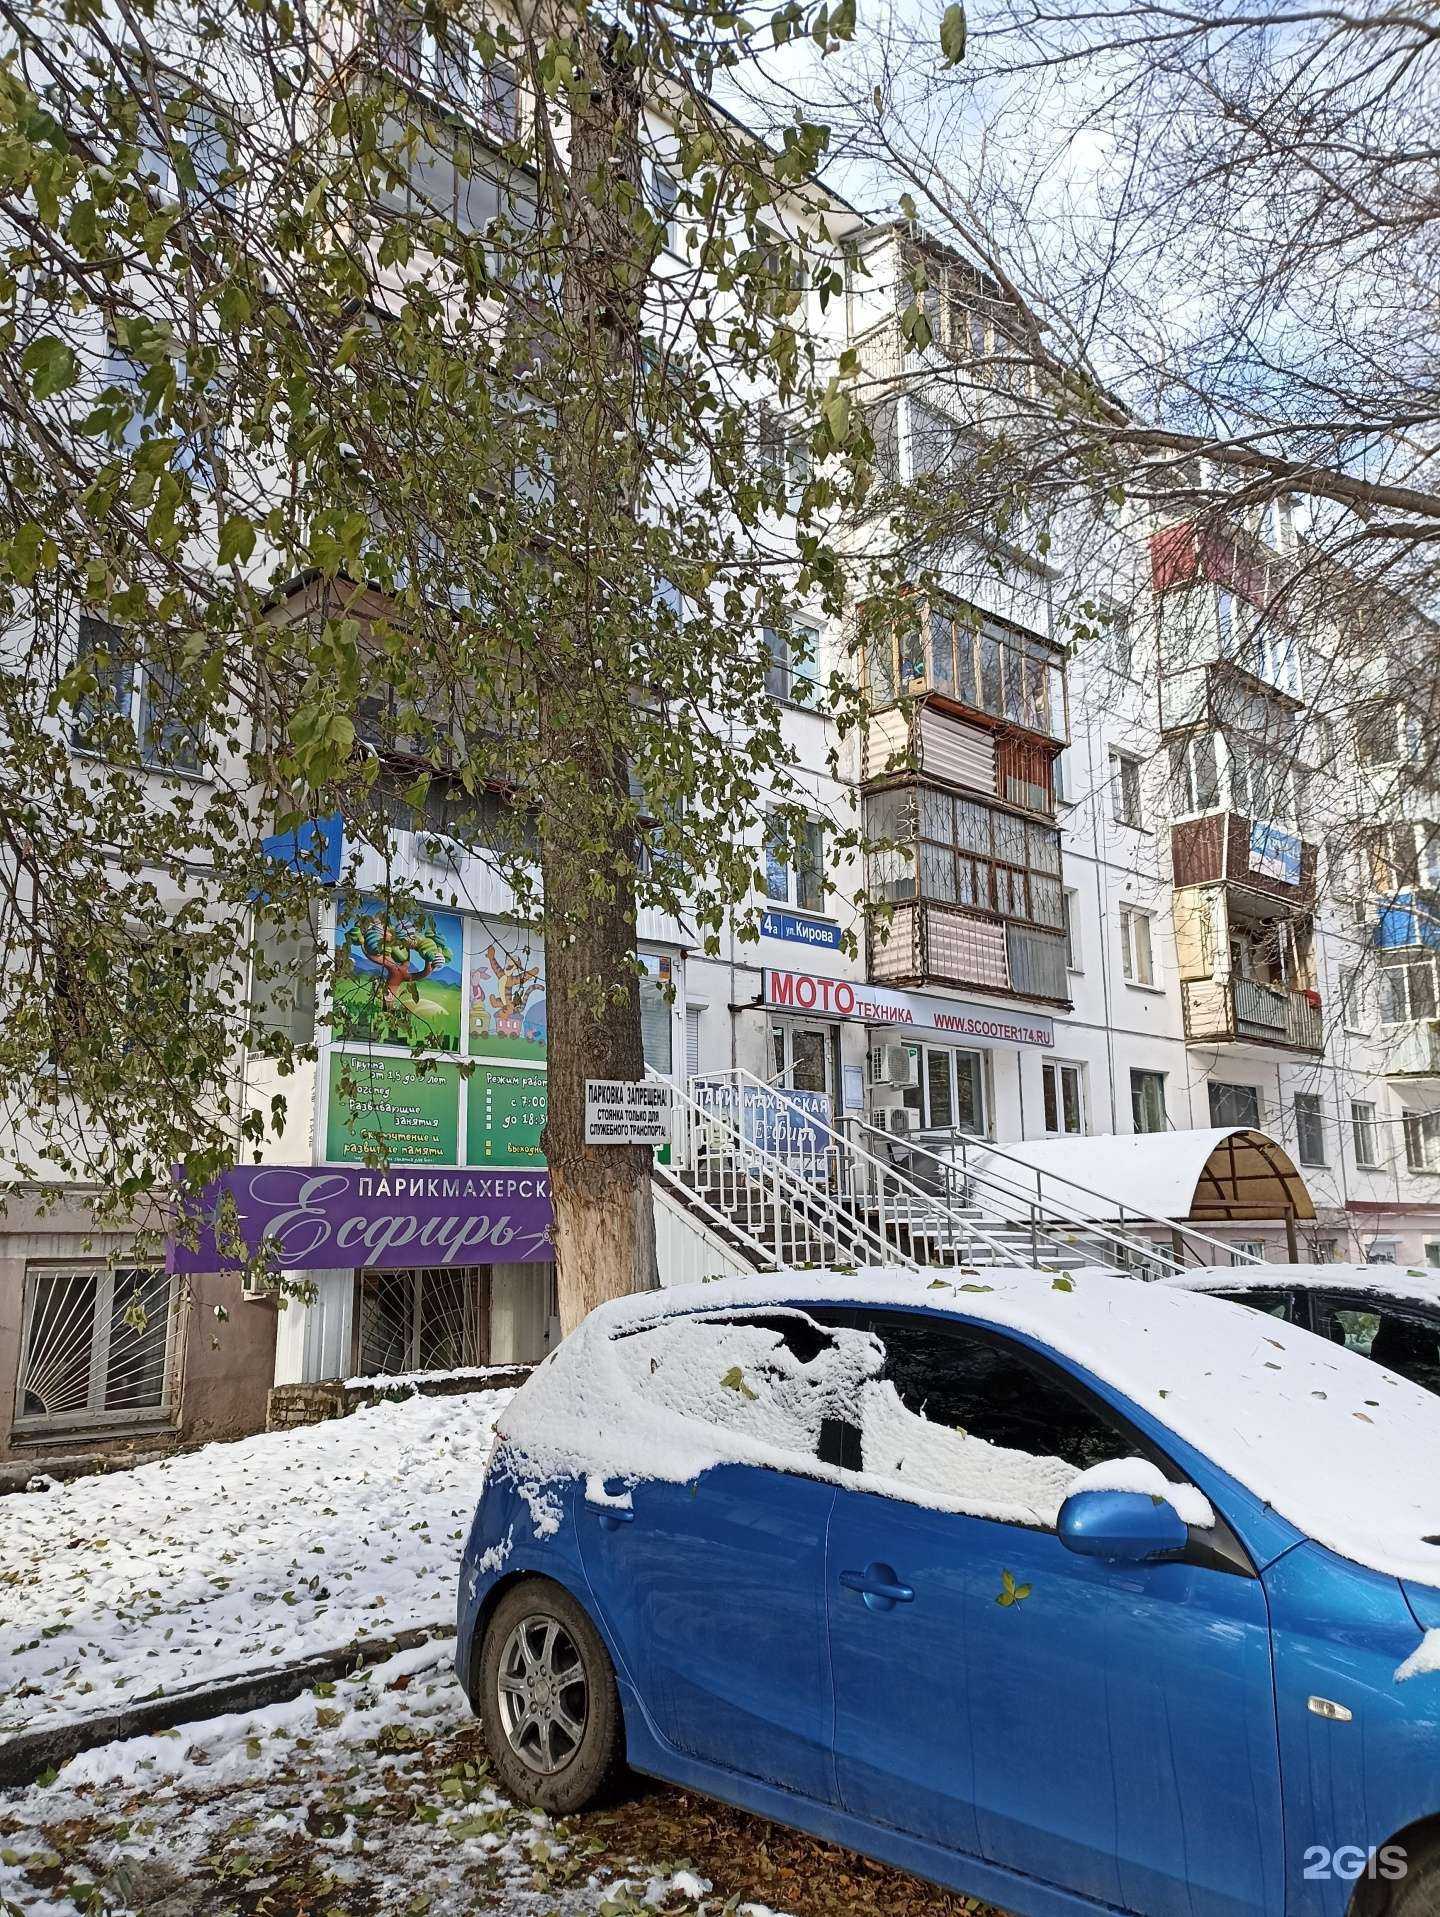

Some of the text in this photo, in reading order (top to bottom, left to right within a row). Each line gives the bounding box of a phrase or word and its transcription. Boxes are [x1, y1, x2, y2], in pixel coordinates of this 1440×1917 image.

[795, 921, 834, 943] Кирова
[933, 1013, 1051, 1045] WWW.SCOOTER174.RU
[486, 1072, 519, 1084] Режим
[352, 1085, 390, 1098] огопед
[588, 1085, 624, 1104] ПАРКОВКА
[521, 1096, 546, 1108] 7:00
[395, 1117, 439, 1128] занятия
[502, 1113, 548, 1128] до 18:3
[597, 1109, 660, 1123] СТОЯНКА ТОЛЬКО ДЛЯ
[589, 1124, 629, 1136] СЛУЖЕБНОГО
[402, 1145, 444, 1155] памяти
[358, 1177, 552, 1199] ПАРИКМАХЕРСК
[249, 1170, 523, 1265] Есфирь
